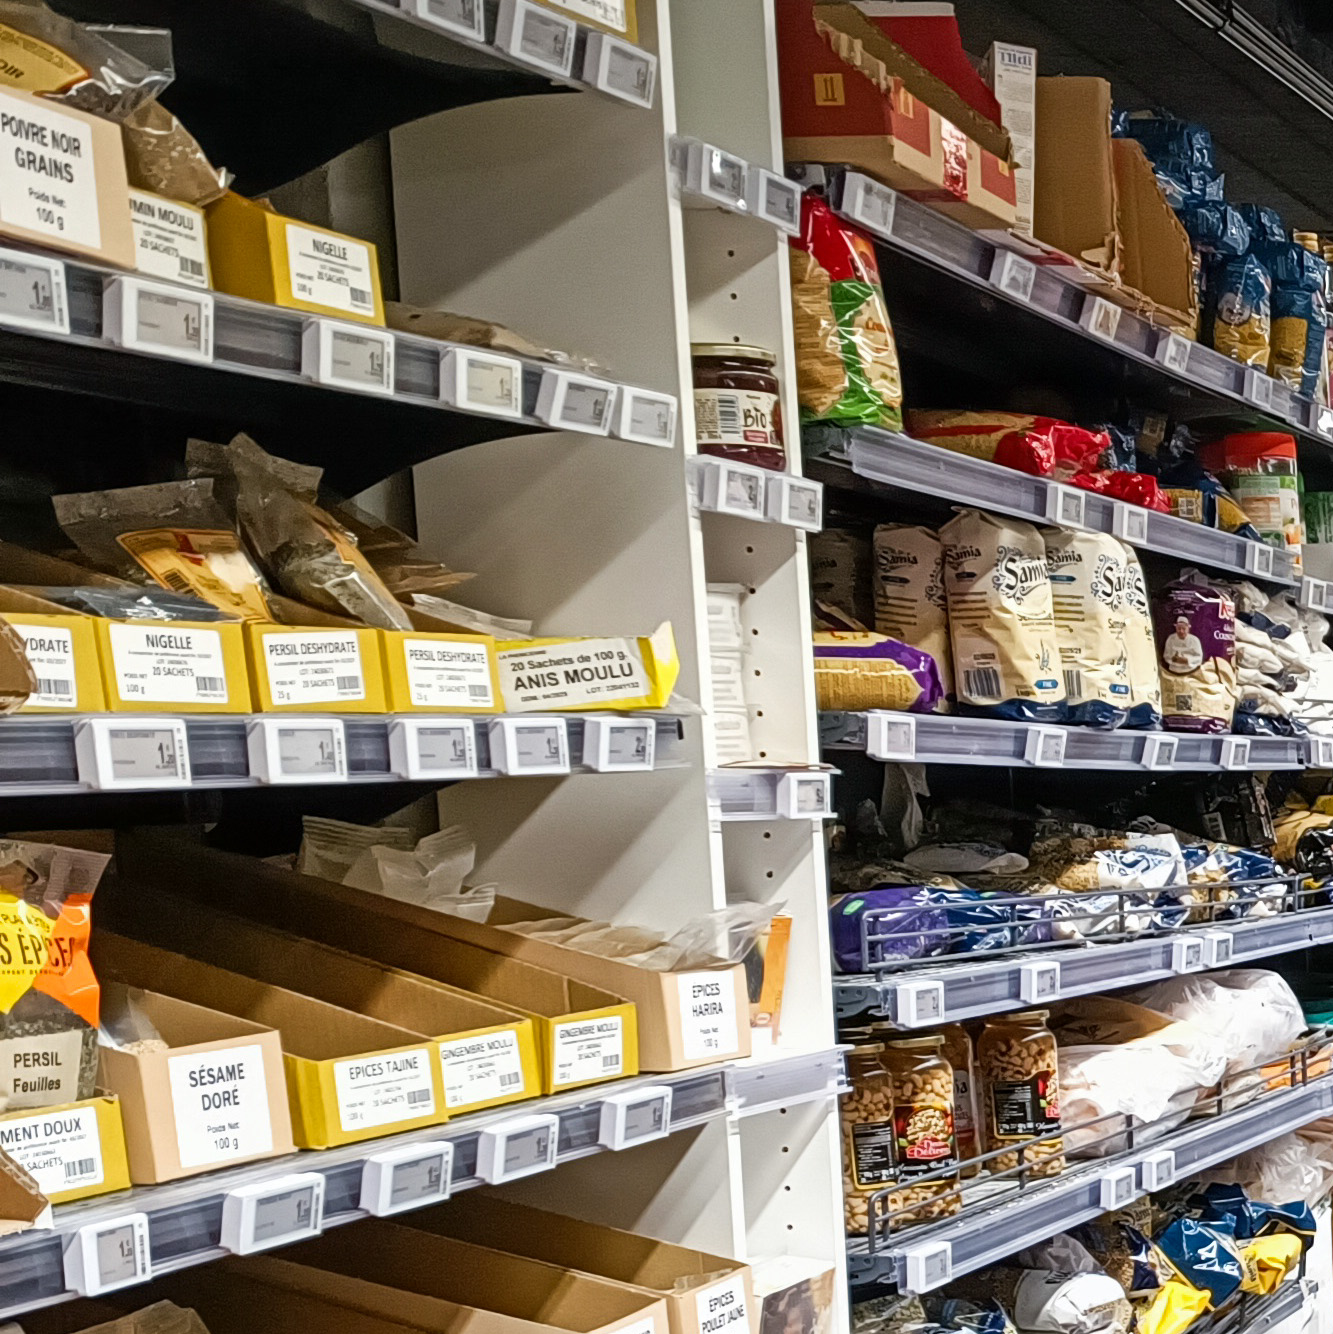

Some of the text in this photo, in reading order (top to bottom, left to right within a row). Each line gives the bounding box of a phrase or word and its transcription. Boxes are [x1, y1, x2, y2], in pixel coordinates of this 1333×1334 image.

[1, 112, 81, 158] POIVRE NOIR
[15, 148, 74, 183] GRAINS
[37, 207, 55, 224] 100
[158, 206, 194, 230] MOULU
[312, 239, 348, 260] NIGELLE
[146, 634, 192, 649] NIGELLE
[269, 642, 356, 655] PERSIL DESHYDRATE
[410, 649, 435, 661] PERSIL
[437, 651, 485, 663] DESHYDRATE
[511, 651, 613, 671] 20 Sachets de 100
[163, 667, 194, 677] SACHETS
[514, 663, 633, 691] ANIS MOULU
[692, 1002, 723, 1018] HARIRA
[13, 1051, 62, 1068] PERSIL
[349, 1056, 418, 1080] EPICES TAJINE
[13, 1077, 61, 1092] Feuilles
[189, 1064, 245, 1087] SÉSAME
[202, 1089, 240, 1111] DORÉ
[44, 1118, 81, 1136] DOUX
[214, 1137, 230, 1150] 100
[709, 1290, 735, 1313] ÉPICES
[702, 1304, 745, 1334] POULET JAUNE
